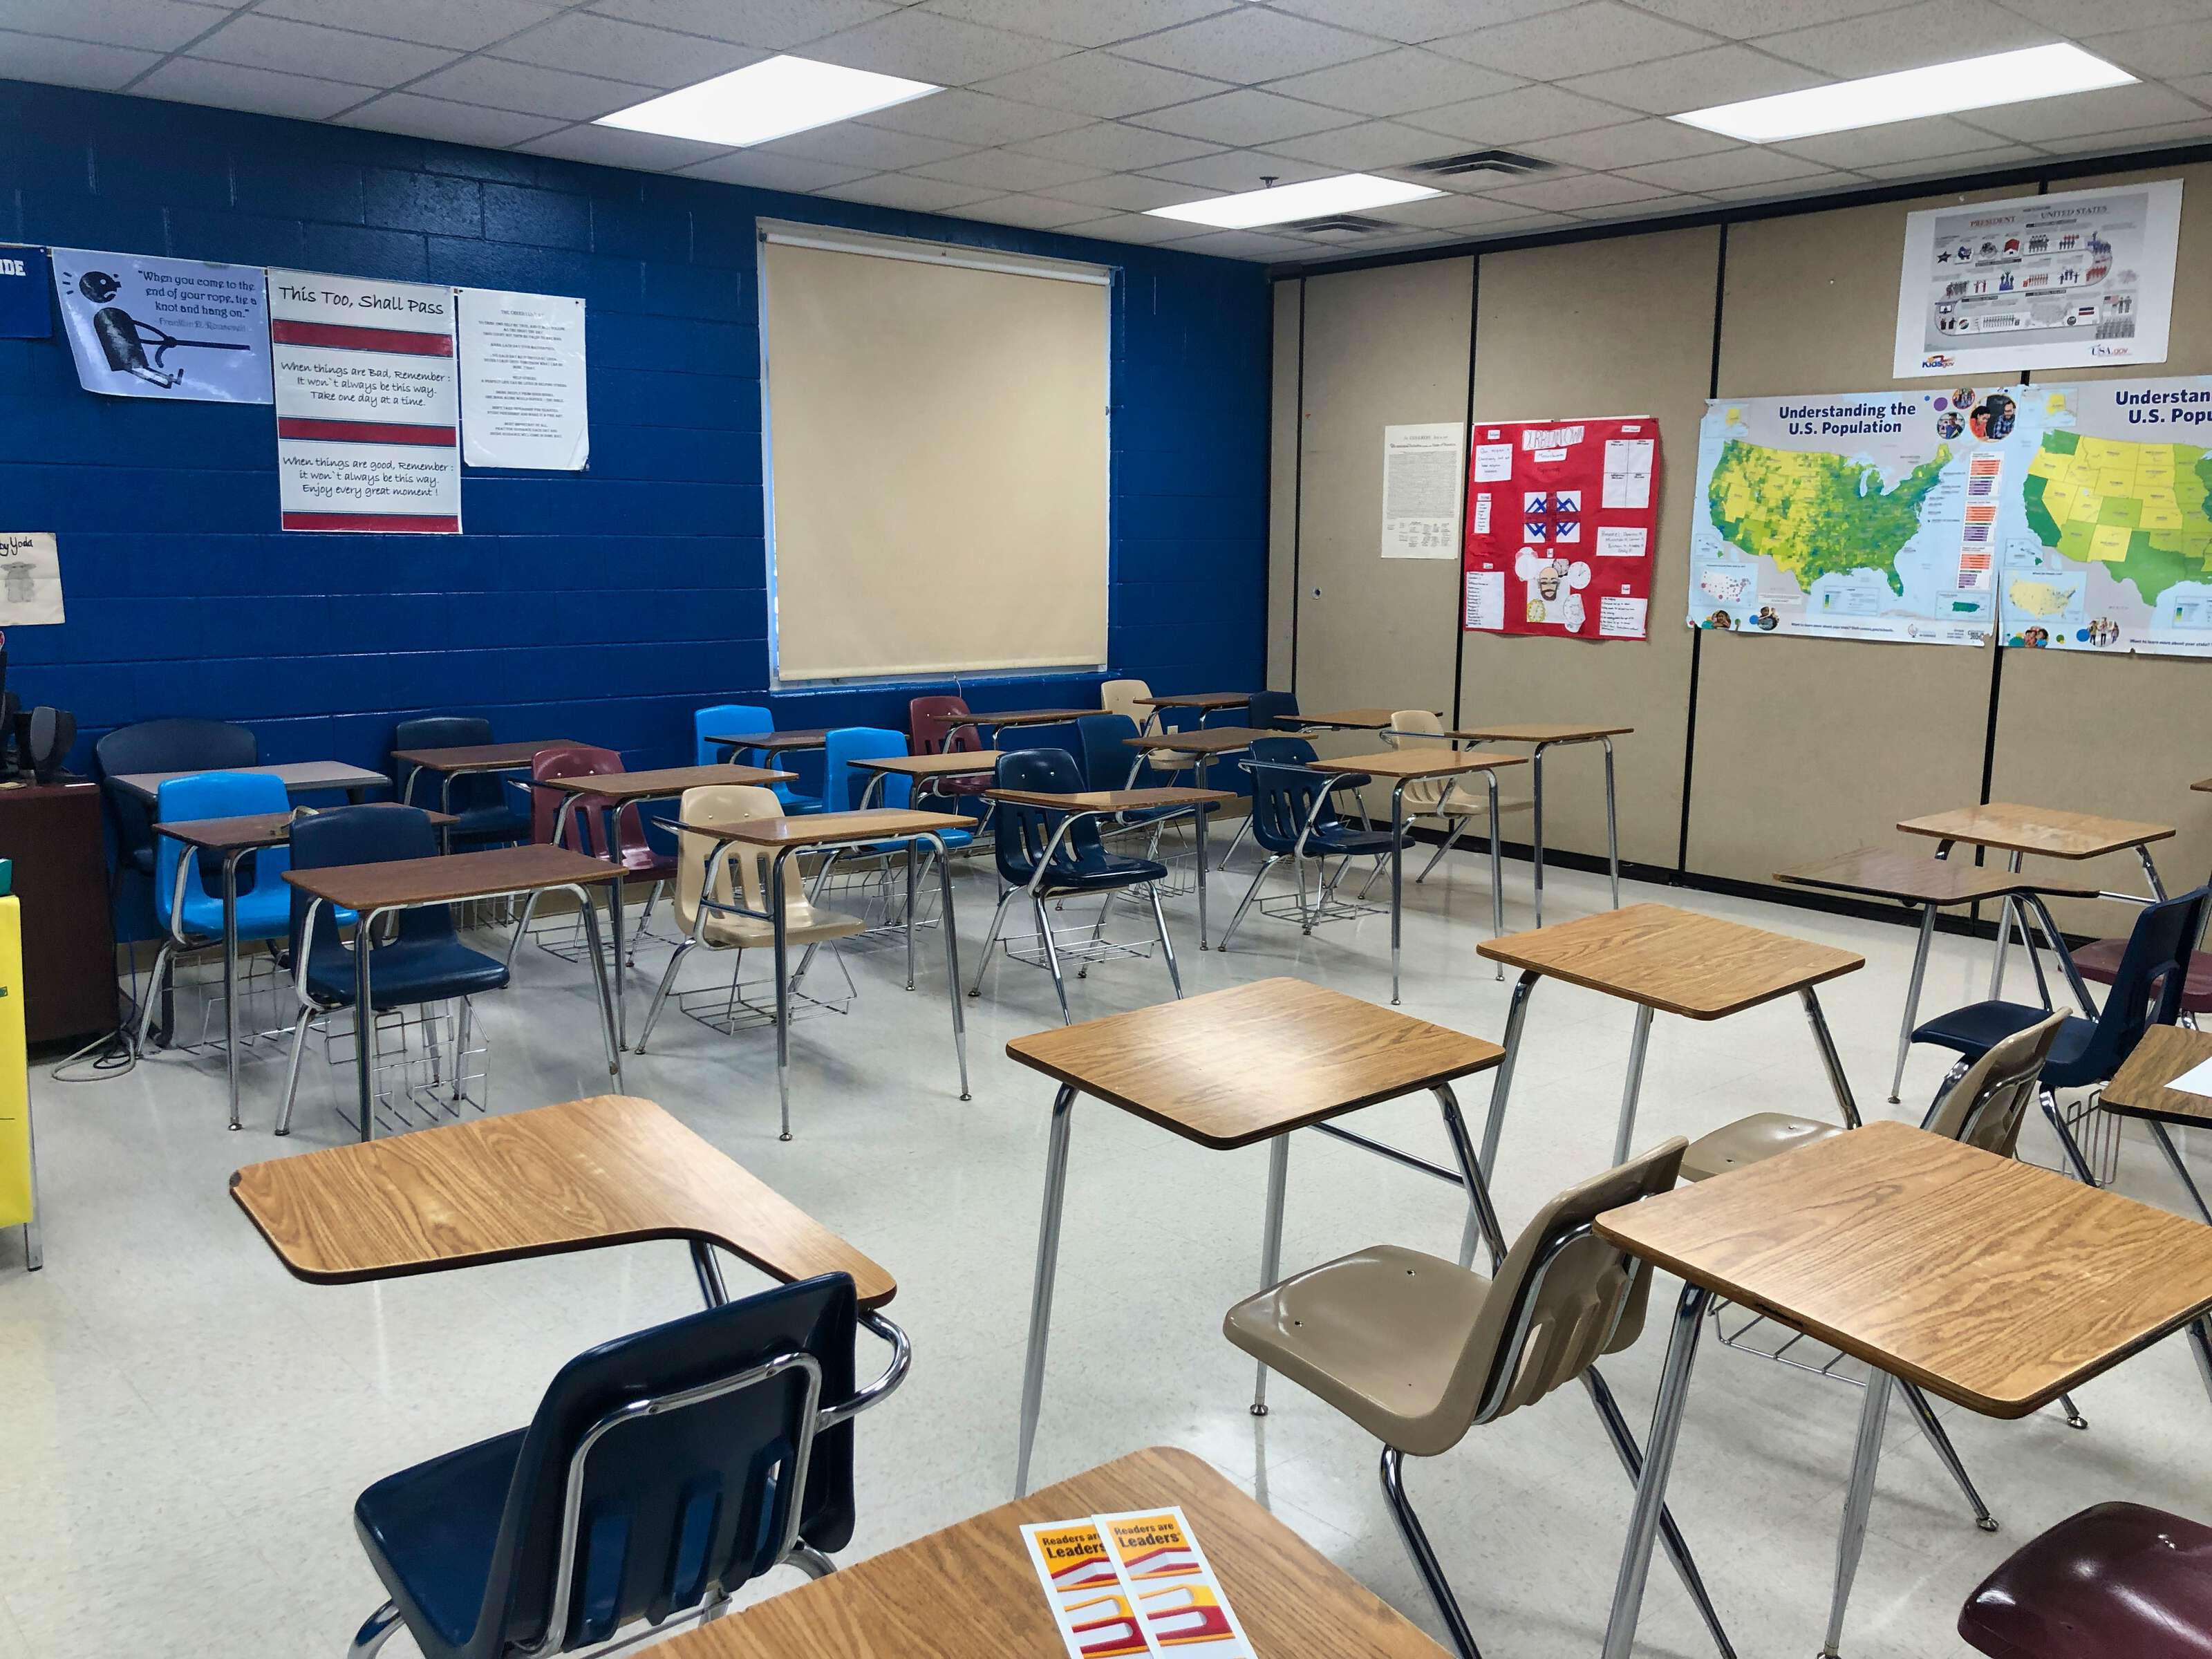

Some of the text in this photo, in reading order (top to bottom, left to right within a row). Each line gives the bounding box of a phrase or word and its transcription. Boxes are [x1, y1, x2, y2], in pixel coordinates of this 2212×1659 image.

[2041, 205, 2108, 219] UNITED STATES
[1970, 216, 2016, 227] PRESIDENT
[175, 277, 194, 285] you
[197, 278, 225, 289] come
[226, 280, 236, 288] to
[238, 281, 255, 291] the
[146, 288, 165, 297] end
[167, 288, 178, 299] of
[180, 291, 206, 301] your
[236, 295, 248, 305] tie
[279, 286, 444, 315] This Too, Shall Pass
[155, 301, 178, 311] knot
[180, 305, 200, 314] and
[203, 306, 228, 319] hang
[281, 362, 311, 372] When
[314, 364, 348, 378] things
[368, 368, 391, 379] Bad,
[394, 371, 445, 382] Remember
[297, 377, 306, 385] It
[341, 380, 377, 394] always
[380, 382, 390, 391] be
[392, 383, 411, 393] this
[413, 386, 437, 398] way.
[310, 391, 336, 401] Take
[358, 393, 377, 407] day
[381, 396, 391, 404] at
[401, 397, 426, 406] time.
[1779, 402, 1916, 419] Understanding the
[2129, 409, 2165, 424] U.S.
[1789, 420, 1902, 437] U.S. Population
[283, 456, 313, 466] When
[315, 458, 350, 468] things
[370, 460, 395, 470] good,
[398, 462, 449, 472] Remember
[344, 473, 380, 485] always
[383, 474, 393, 482] be
[395, 474, 414, 483] this
[416, 476, 440, 487] way.
[303, 483, 332, 498] Enjoy
[335, 487, 362, 498] every
[364, 487, 391, 498] great
[10, 536, 33, 555] Yoda
[1114, 1522, 1174, 1535] Readers are
[1042, 1535, 1085, 1546] Readers
[1046, 1542, 1106, 1559] Leaders
